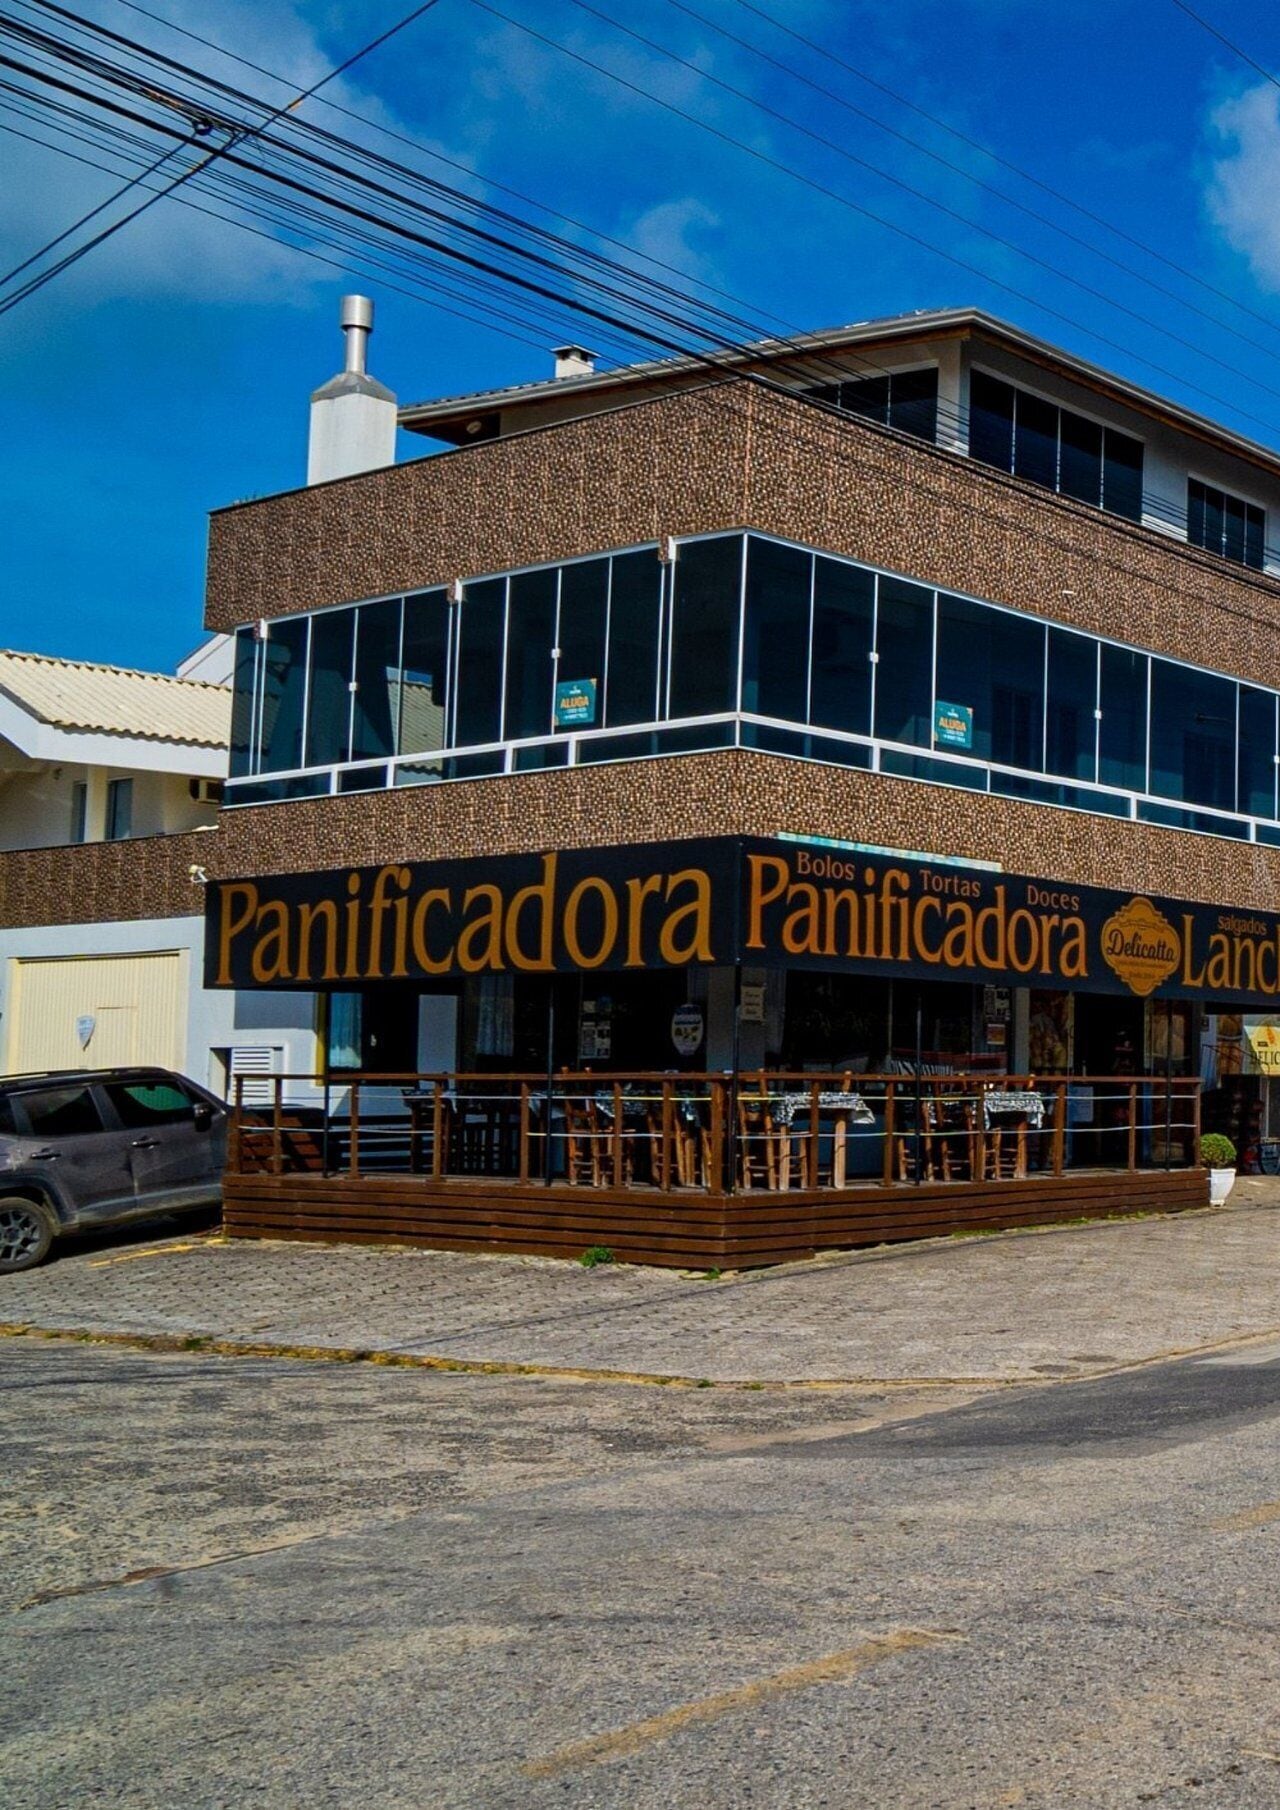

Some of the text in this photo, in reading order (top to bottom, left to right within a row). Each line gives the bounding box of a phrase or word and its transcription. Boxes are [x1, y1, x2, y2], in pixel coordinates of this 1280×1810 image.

[560, 696, 589, 709] ALUGA
[939, 716, 967, 732] ALUGA
[797, 851, 1080, 911] Bolos Tortas Doces
[217, 852, 716, 985] Panificadora
[746, 854, 1088, 977] Panificadora
[1218, 915, 1267, 936] salgados
[1106, 928, 1175, 962] Delicatta
